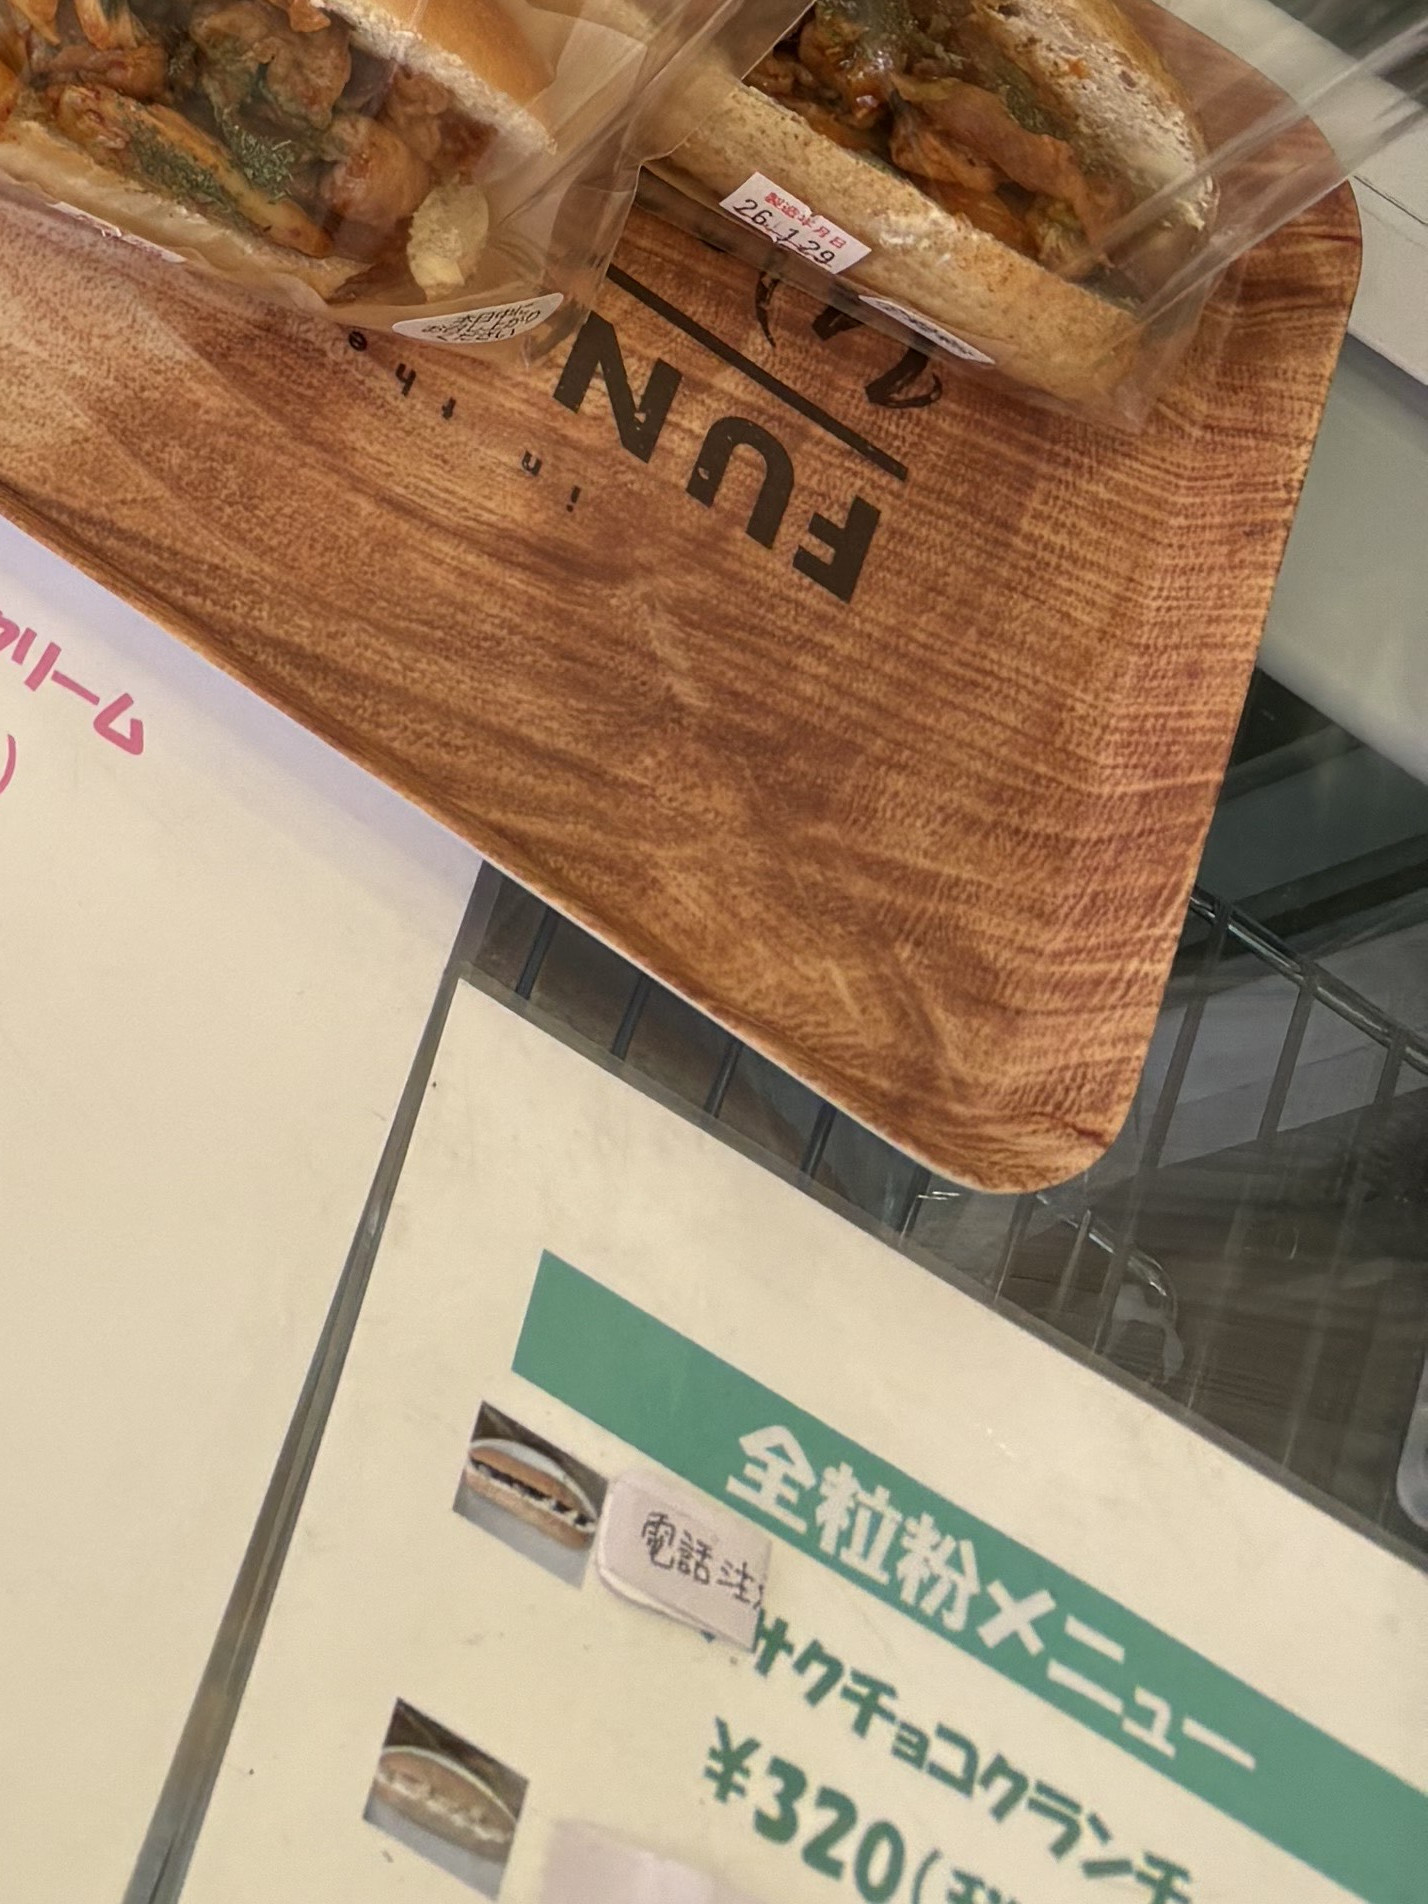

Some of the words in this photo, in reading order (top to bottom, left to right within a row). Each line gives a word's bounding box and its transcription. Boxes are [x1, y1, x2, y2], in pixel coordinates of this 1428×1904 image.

[552, 310, 883, 604] FUN
[641, 1510, 766, 1609] 電話注
[724, 1421, 1259, 1775] 全粒粉メニュー
[701, 1607, 1193, 1904] サクチョコクランチ
